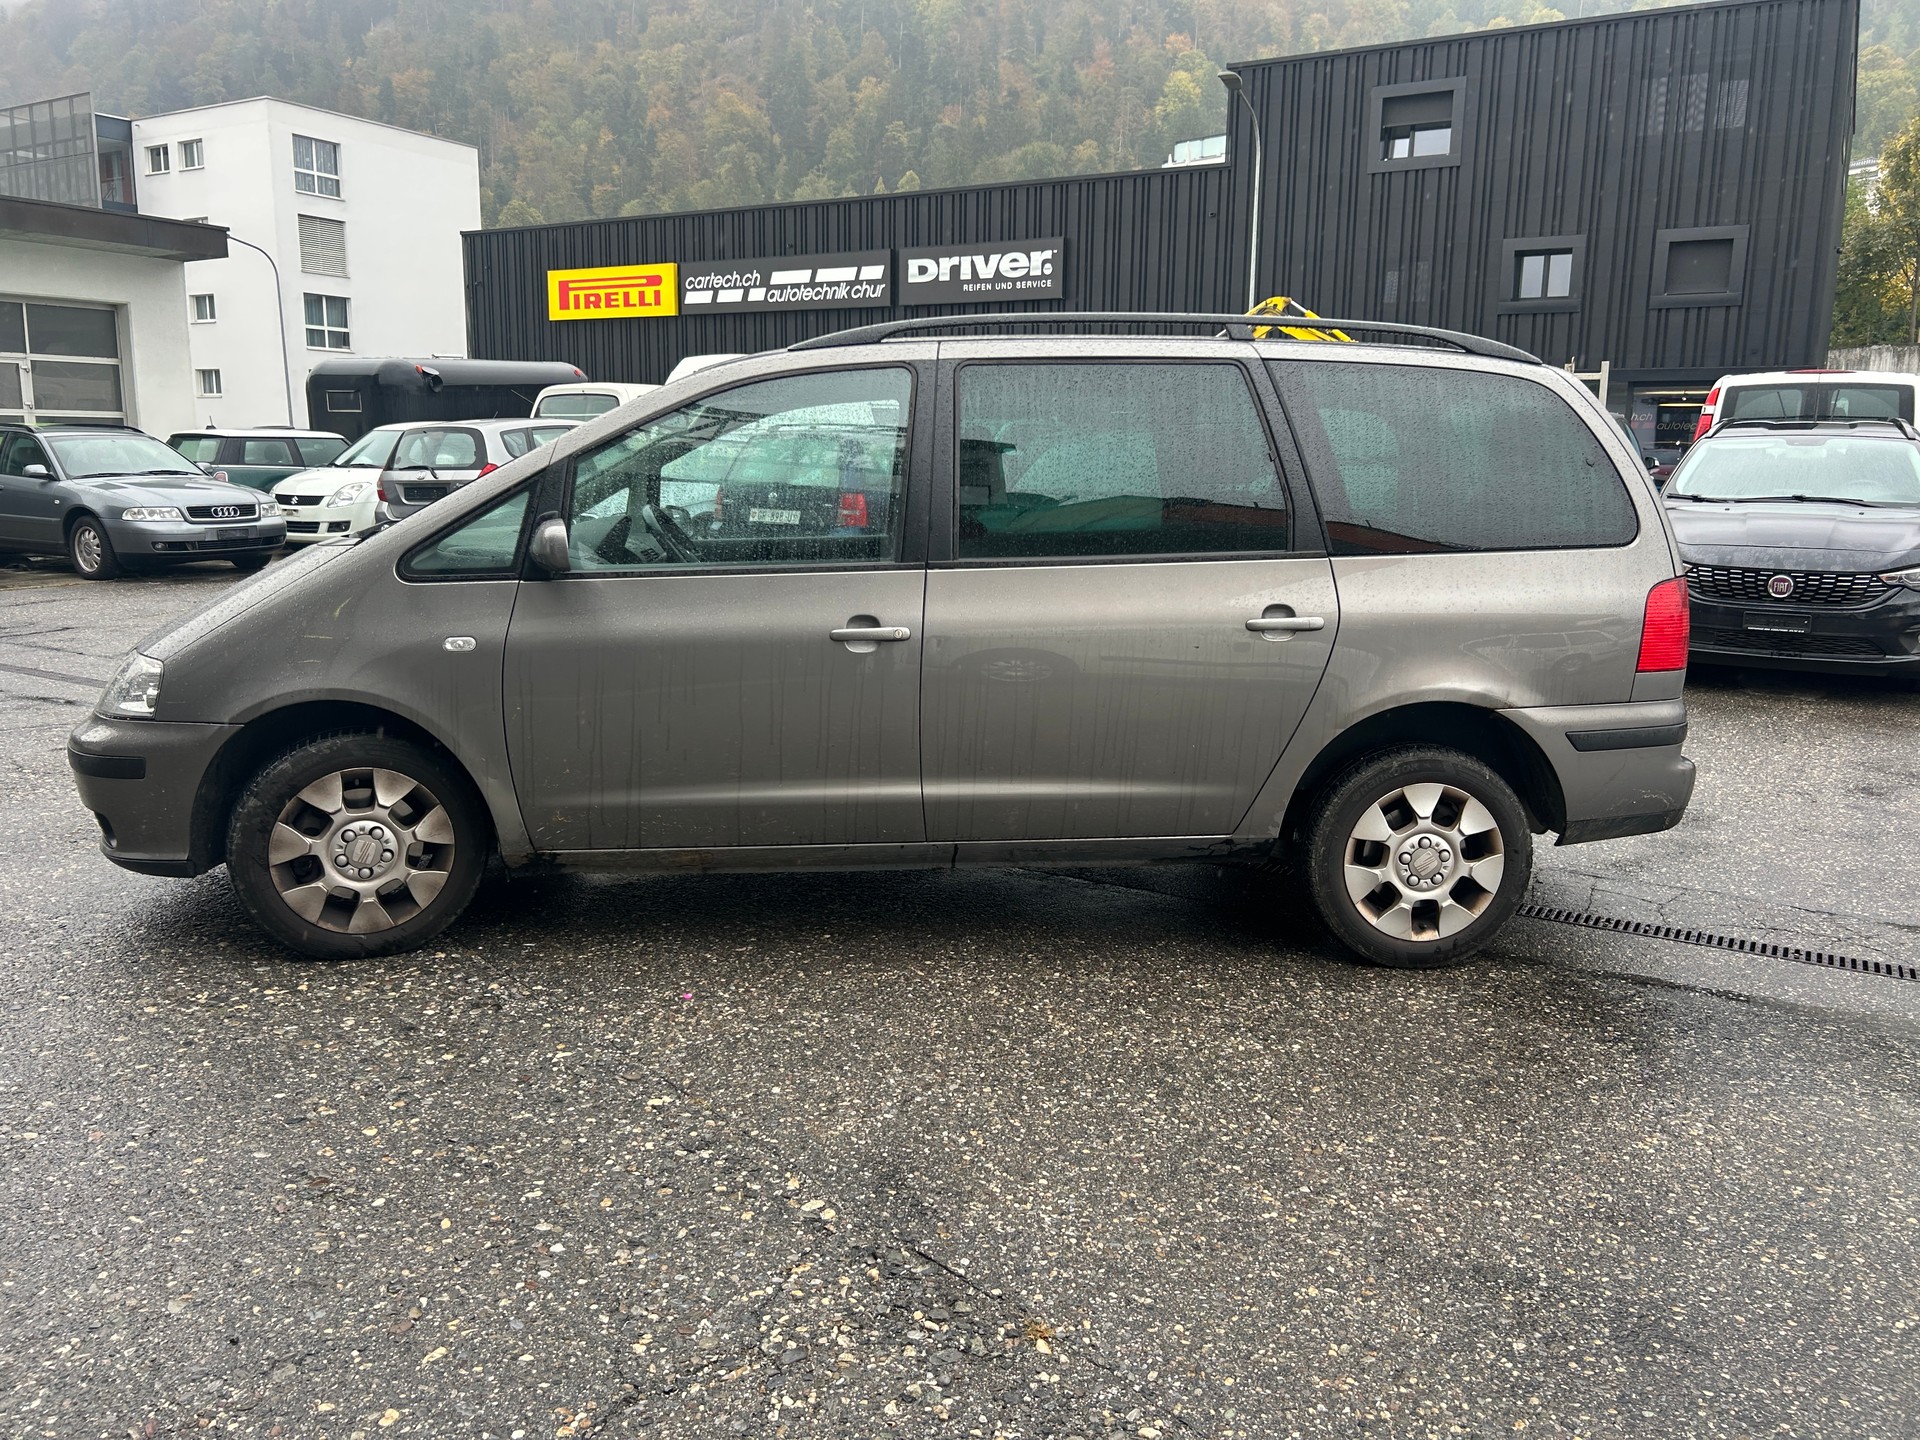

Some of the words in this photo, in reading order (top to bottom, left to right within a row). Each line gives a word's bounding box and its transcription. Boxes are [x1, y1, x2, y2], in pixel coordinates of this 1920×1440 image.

[685, 269, 761, 289] cartech.ch
[963, 282, 992, 292] REIFEN
[995, 281, 1013, 291] UND
[1016, 279, 1052, 290] SERVICE
[558, 274, 662, 310] PIRELLI
[767, 282, 850, 303] autotechnik
[851, 281, 886, 299] chur
[1773, 581, 1789, 593] FIAT
